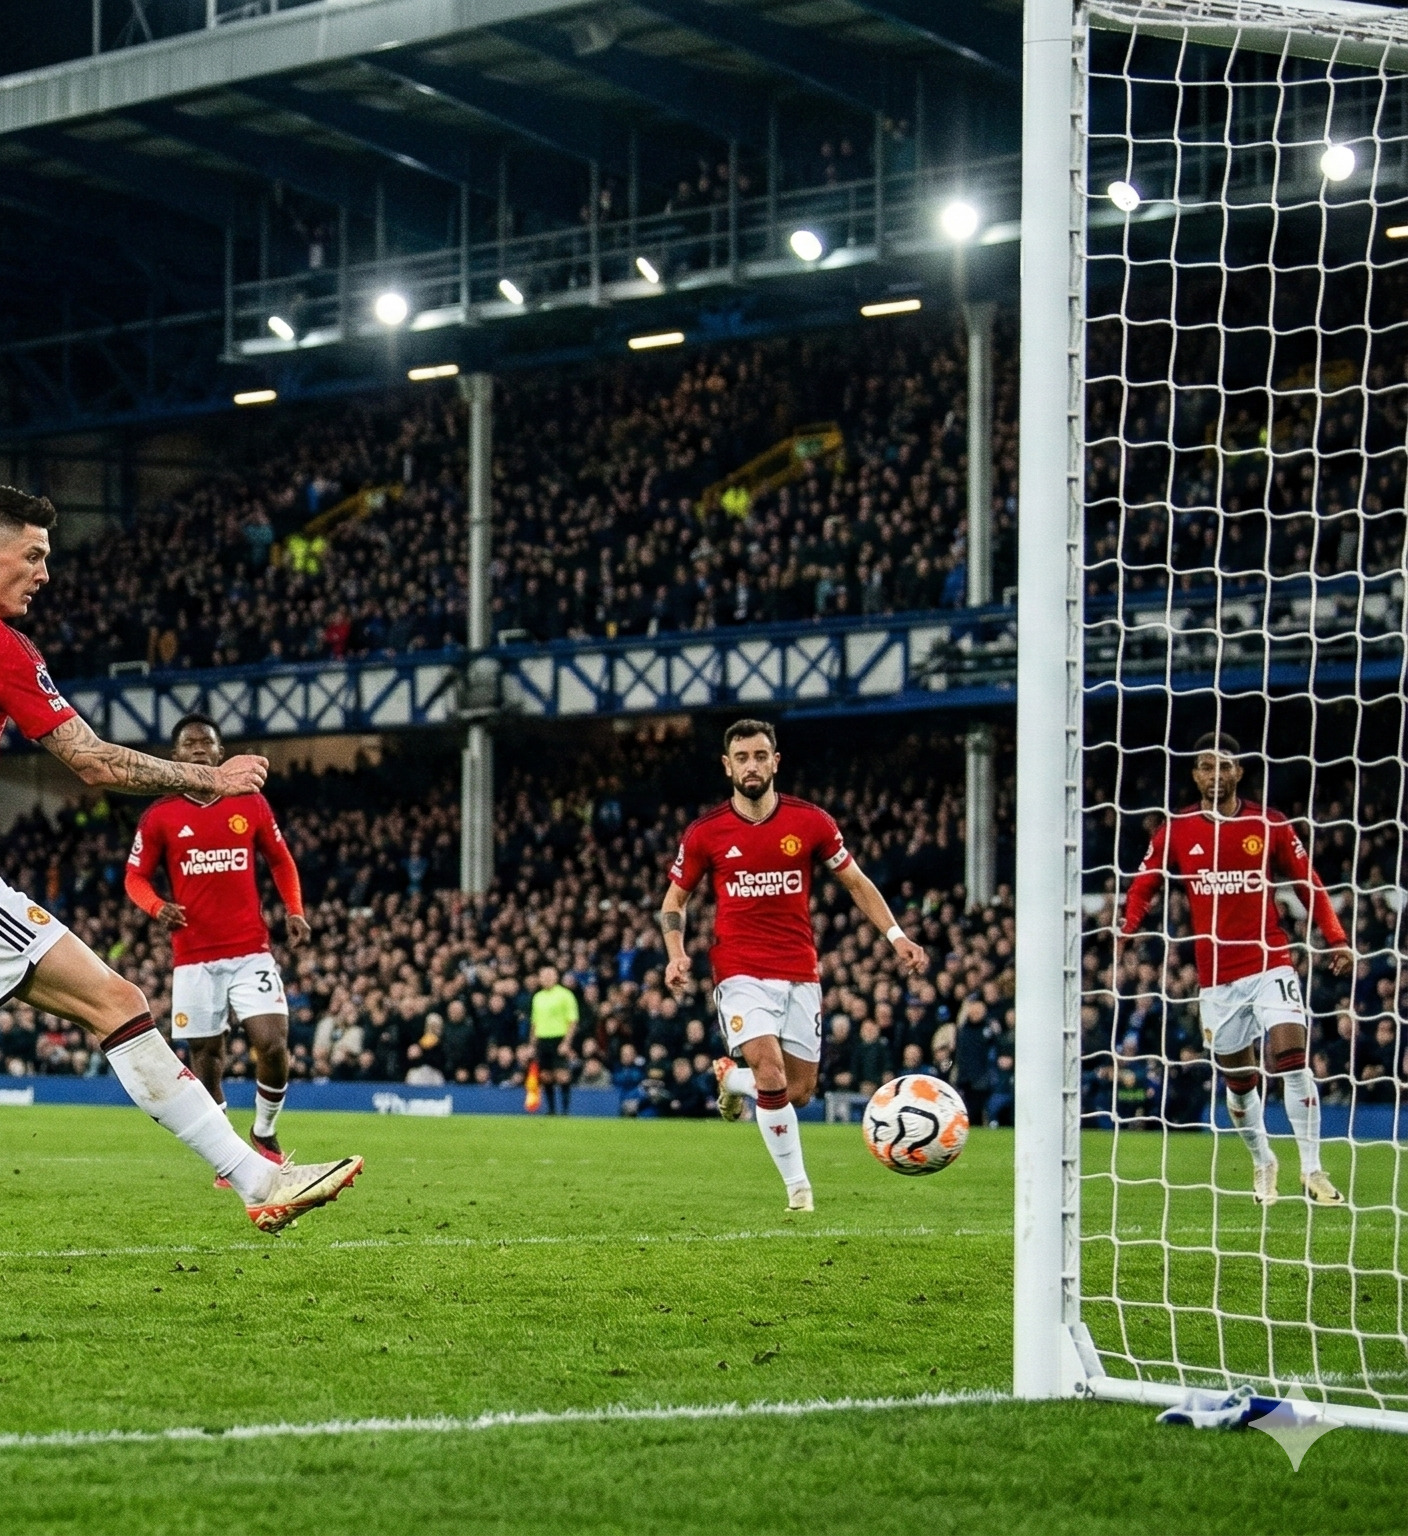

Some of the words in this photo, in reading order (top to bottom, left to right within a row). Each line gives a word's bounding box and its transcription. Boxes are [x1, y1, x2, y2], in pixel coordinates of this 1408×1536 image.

[186, 848, 232, 864] Team
[734, 870, 783, 886] Team
[1197, 868, 1243, 884] Team
[1275, 978, 1300, 1003] 16
